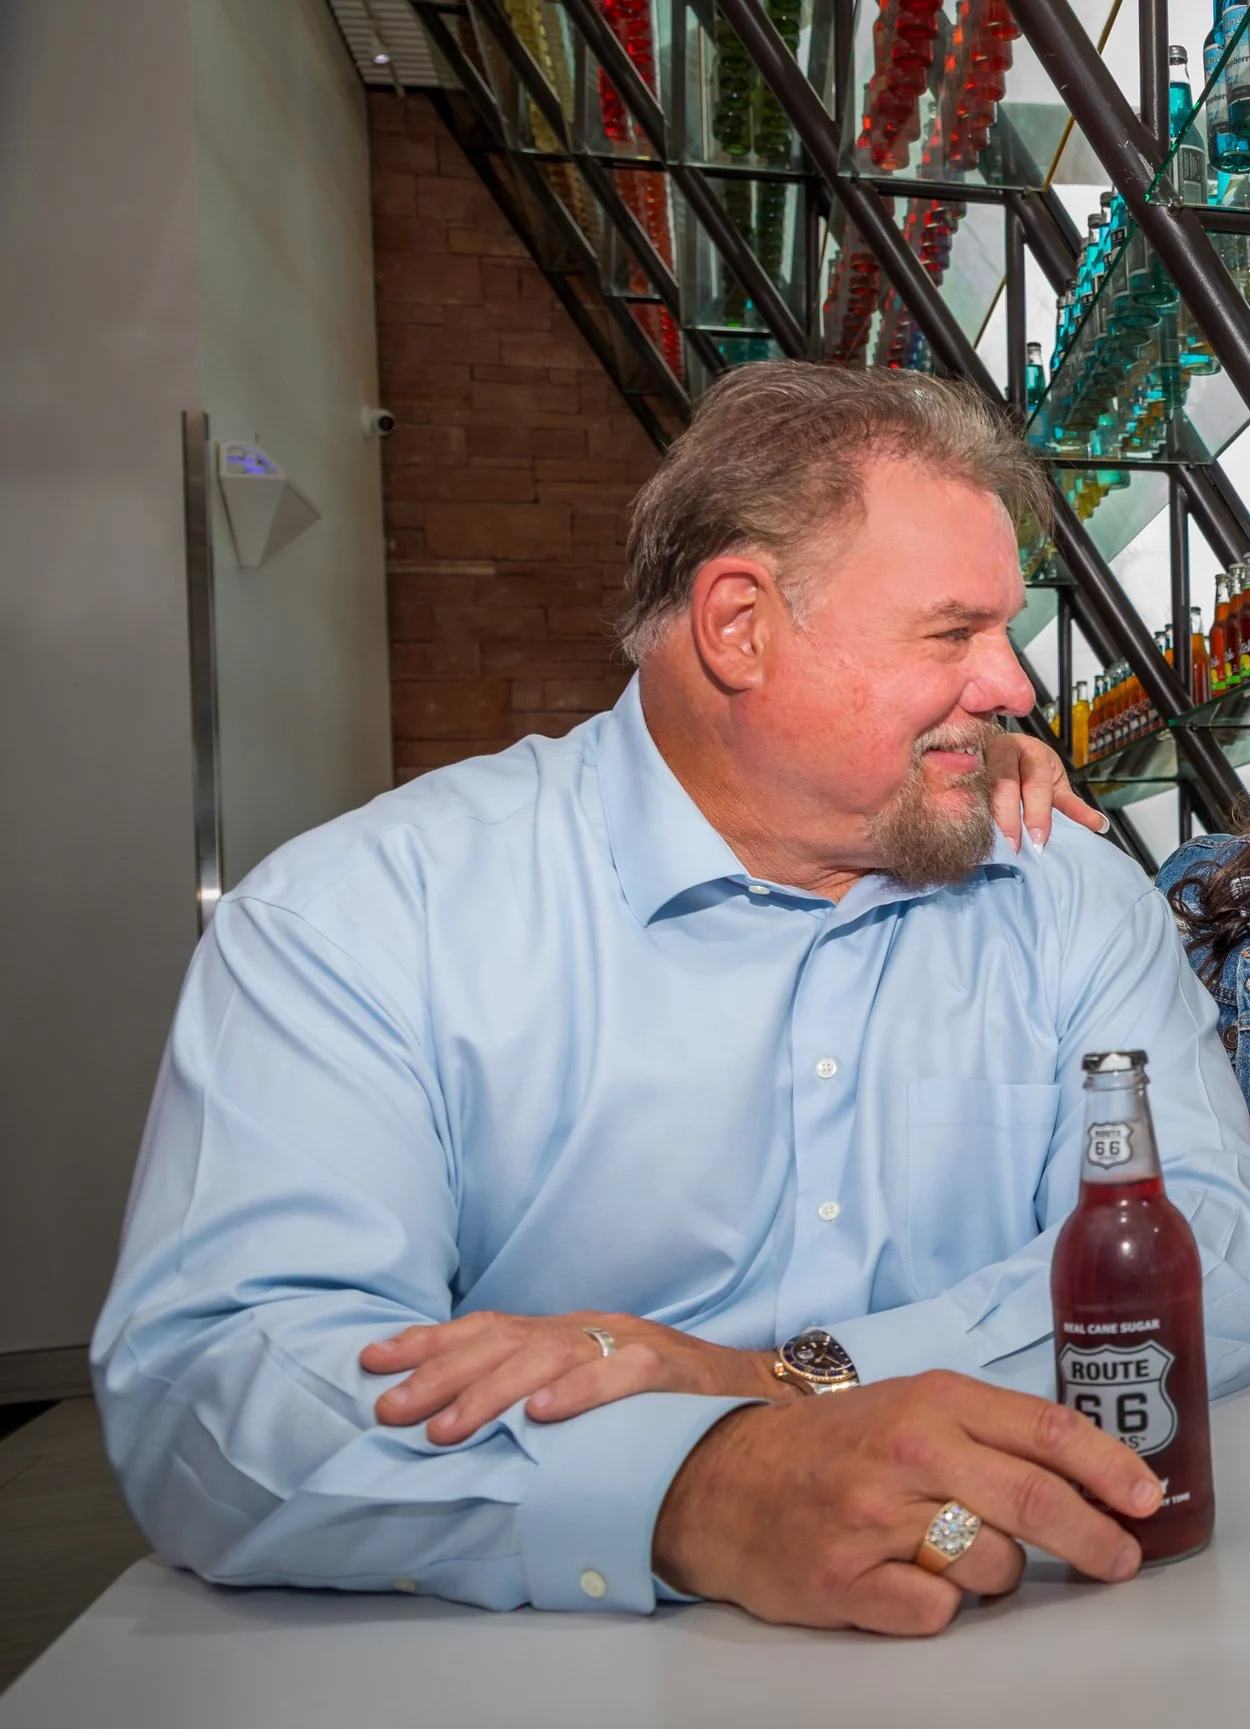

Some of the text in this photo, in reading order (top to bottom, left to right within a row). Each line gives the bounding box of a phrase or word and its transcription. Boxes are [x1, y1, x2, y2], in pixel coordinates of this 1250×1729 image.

[1095, 1141, 1120, 1155] 66
[1087, 1321, 1118, 1335] CANE
[1120, 1318, 1160, 1334] SUGAR
[1071, 1359, 1149, 1381] ROUTE
